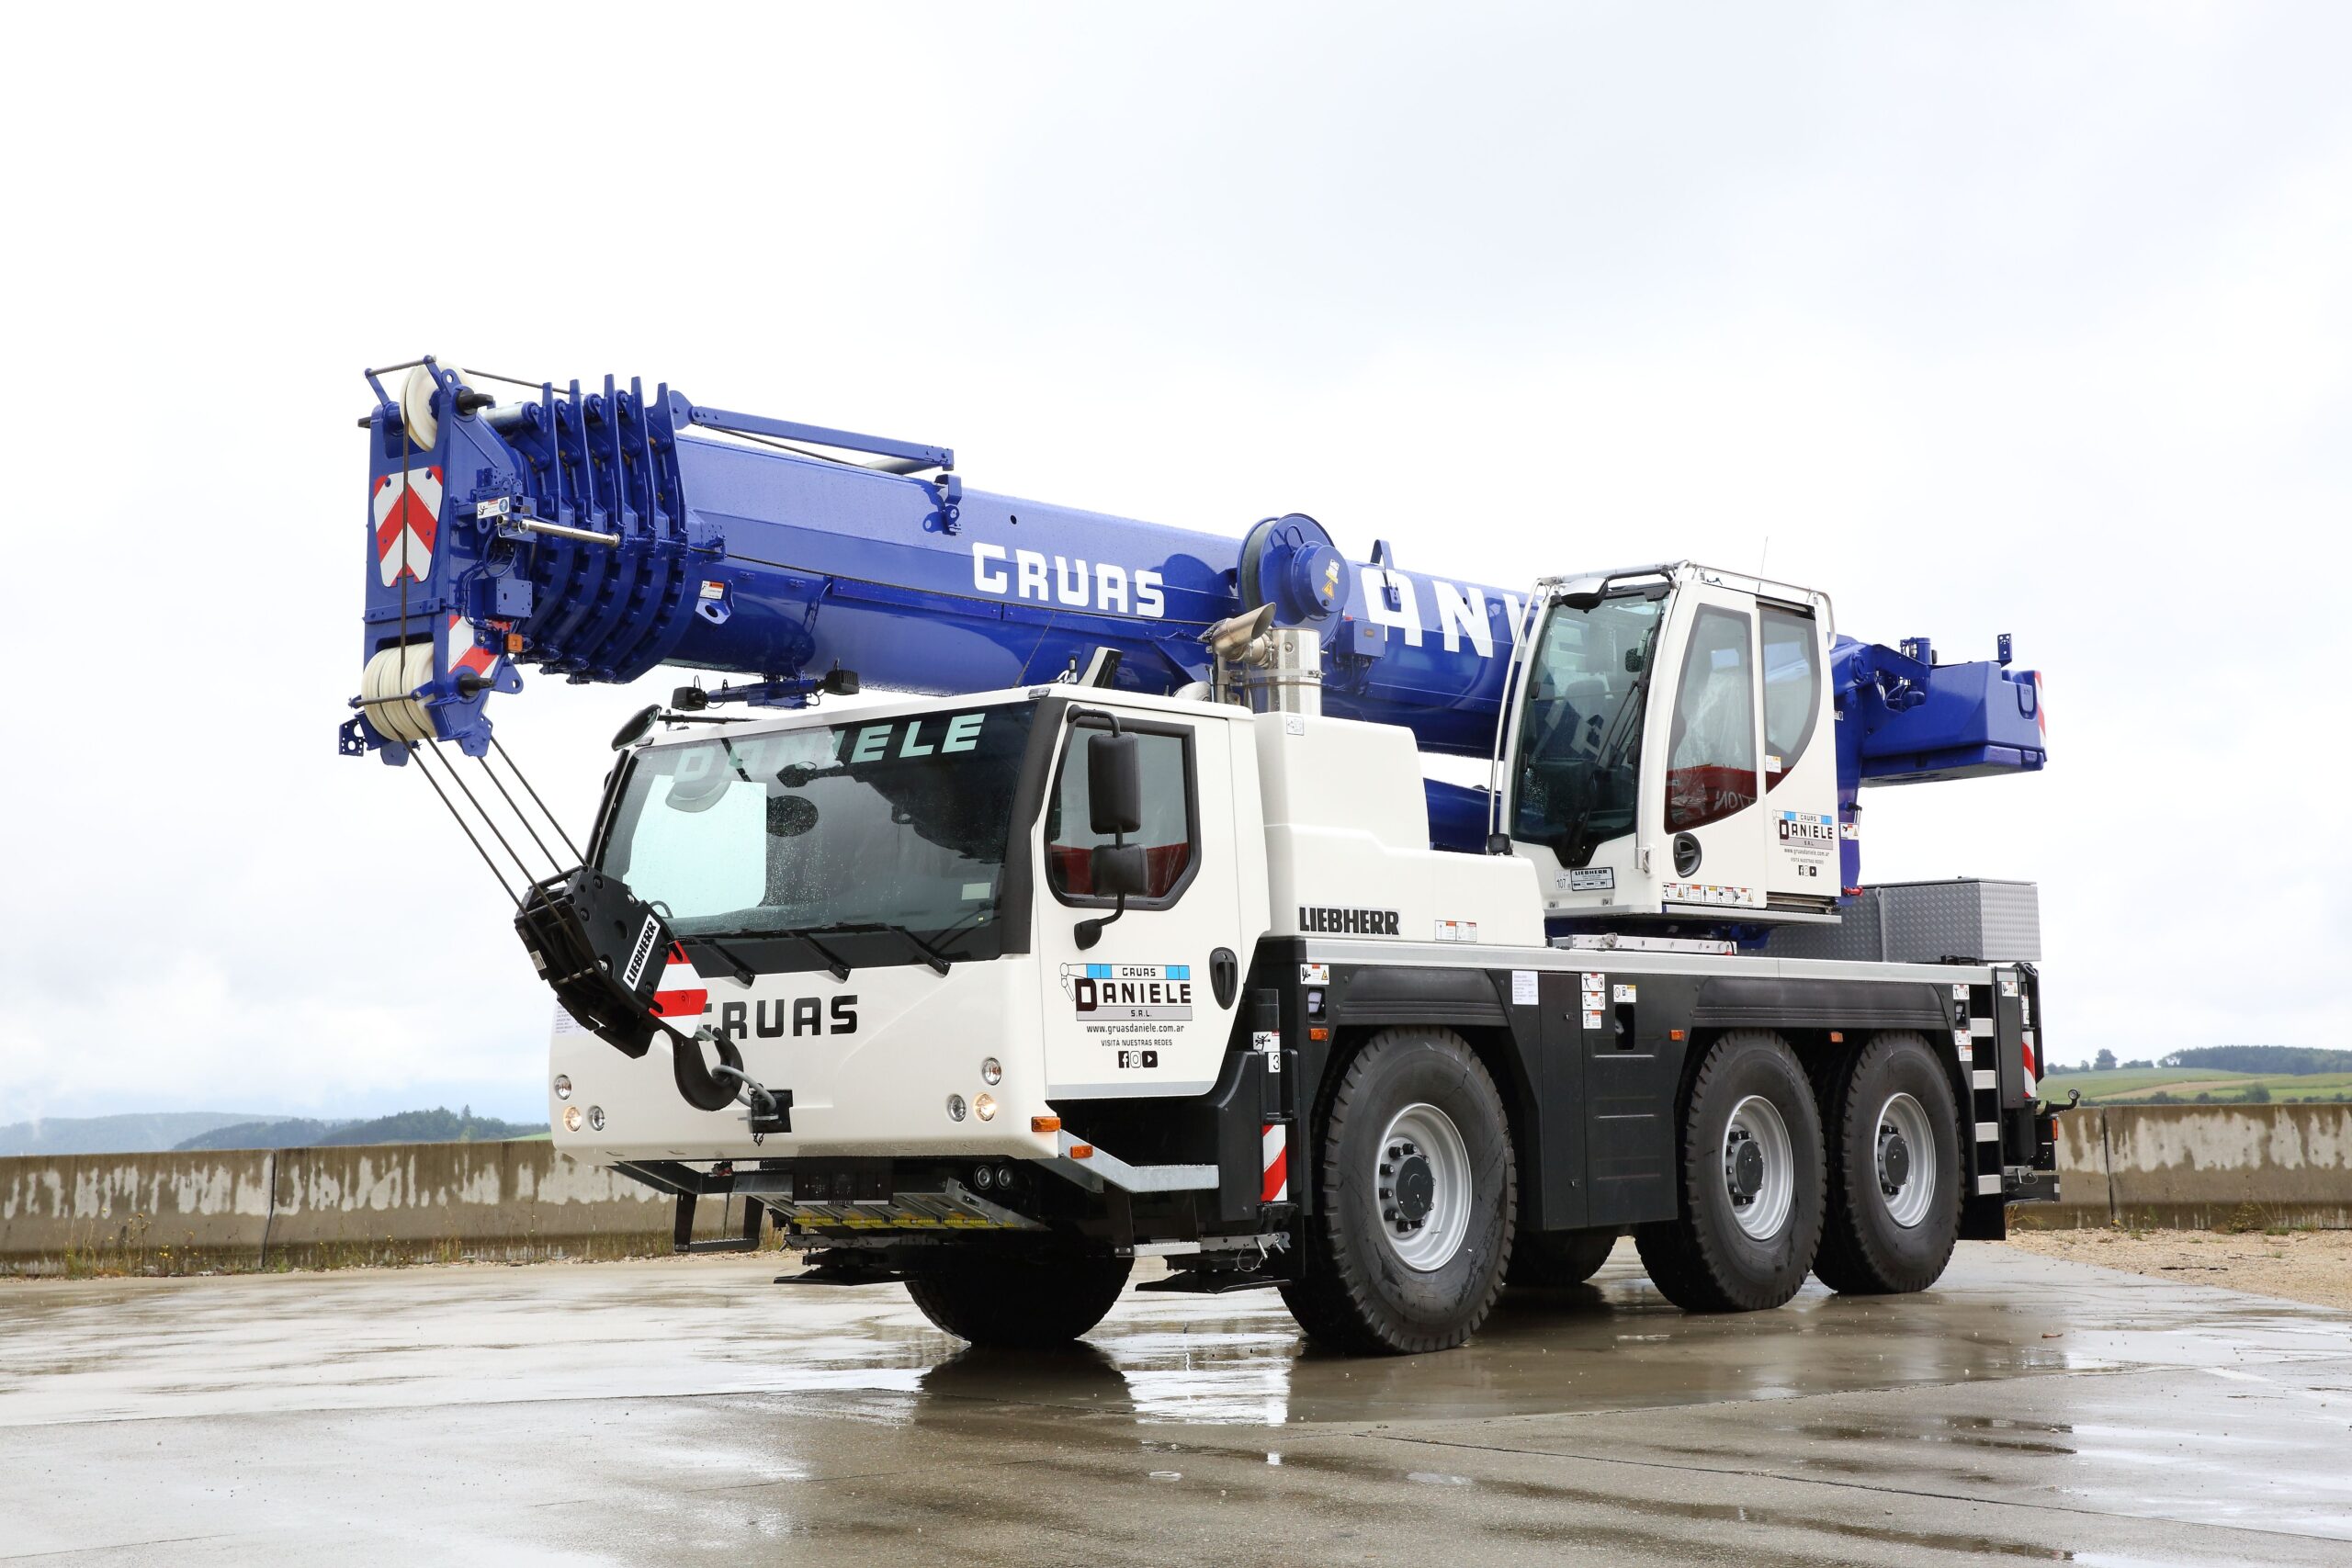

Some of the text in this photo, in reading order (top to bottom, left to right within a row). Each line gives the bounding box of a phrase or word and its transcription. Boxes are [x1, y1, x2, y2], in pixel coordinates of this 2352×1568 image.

[972, 542, 1165, 618] GRUAS
[1779, 819, 1833, 840] DANIELE
[1299, 907, 1400, 935] LIEBHERR
[626, 920, 657, 986] LIEBHERR
[1122, 967, 1157, 977] GRUAS
[1075, 978, 1192, 1011] DANIELE
[1086, 1023, 1184, 1035] www.gruasdaniele.com.ar
